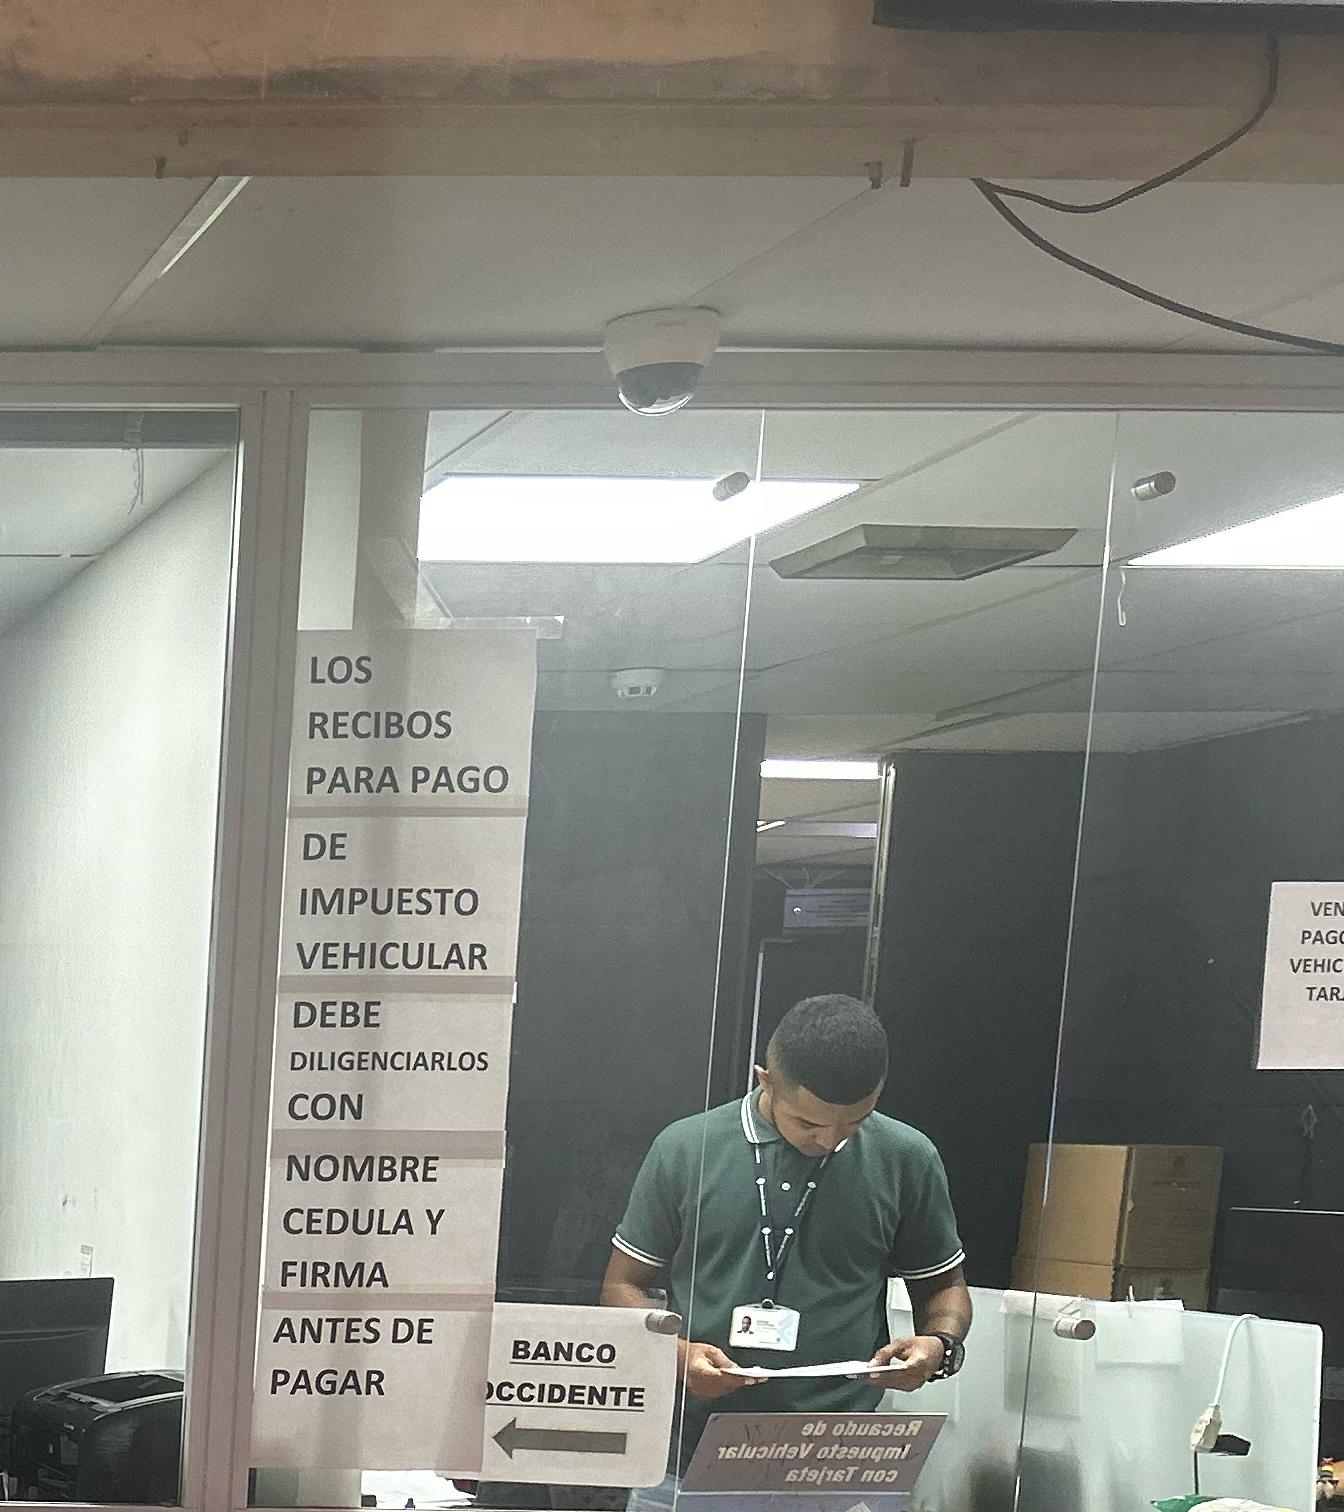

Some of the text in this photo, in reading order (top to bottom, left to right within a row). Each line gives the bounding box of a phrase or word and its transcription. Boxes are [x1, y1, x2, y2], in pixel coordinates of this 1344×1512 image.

[310, 655, 373, 685] LOS
[308, 711, 452, 739] RECIBOS
[305, 765, 509, 795] PARA PAGO
[302, 832, 347, 861] DE
[299, 888, 479, 916] IMPUESTO
[1311, 902, 1344, 917] VEN
[296, 942, 488, 970] VEHICULAR
[1290, 958, 1344, 973] VEHIC
[293, 1000, 381, 1028] DEBE
[290, 1051, 489, 1072] DILIGENCIARLOS
[288, 1093, 363, 1121] CON
[286, 1155, 439, 1183] NOMBRE
[283, 1207, 445, 1236] CEDULA Y
[280, 1261, 389, 1288] FIRMA
[272, 1317, 434, 1344] ANTES DE
[512, 1340, 616, 1363] BANCO
[270, 1369, 385, 1396] PAGAR
